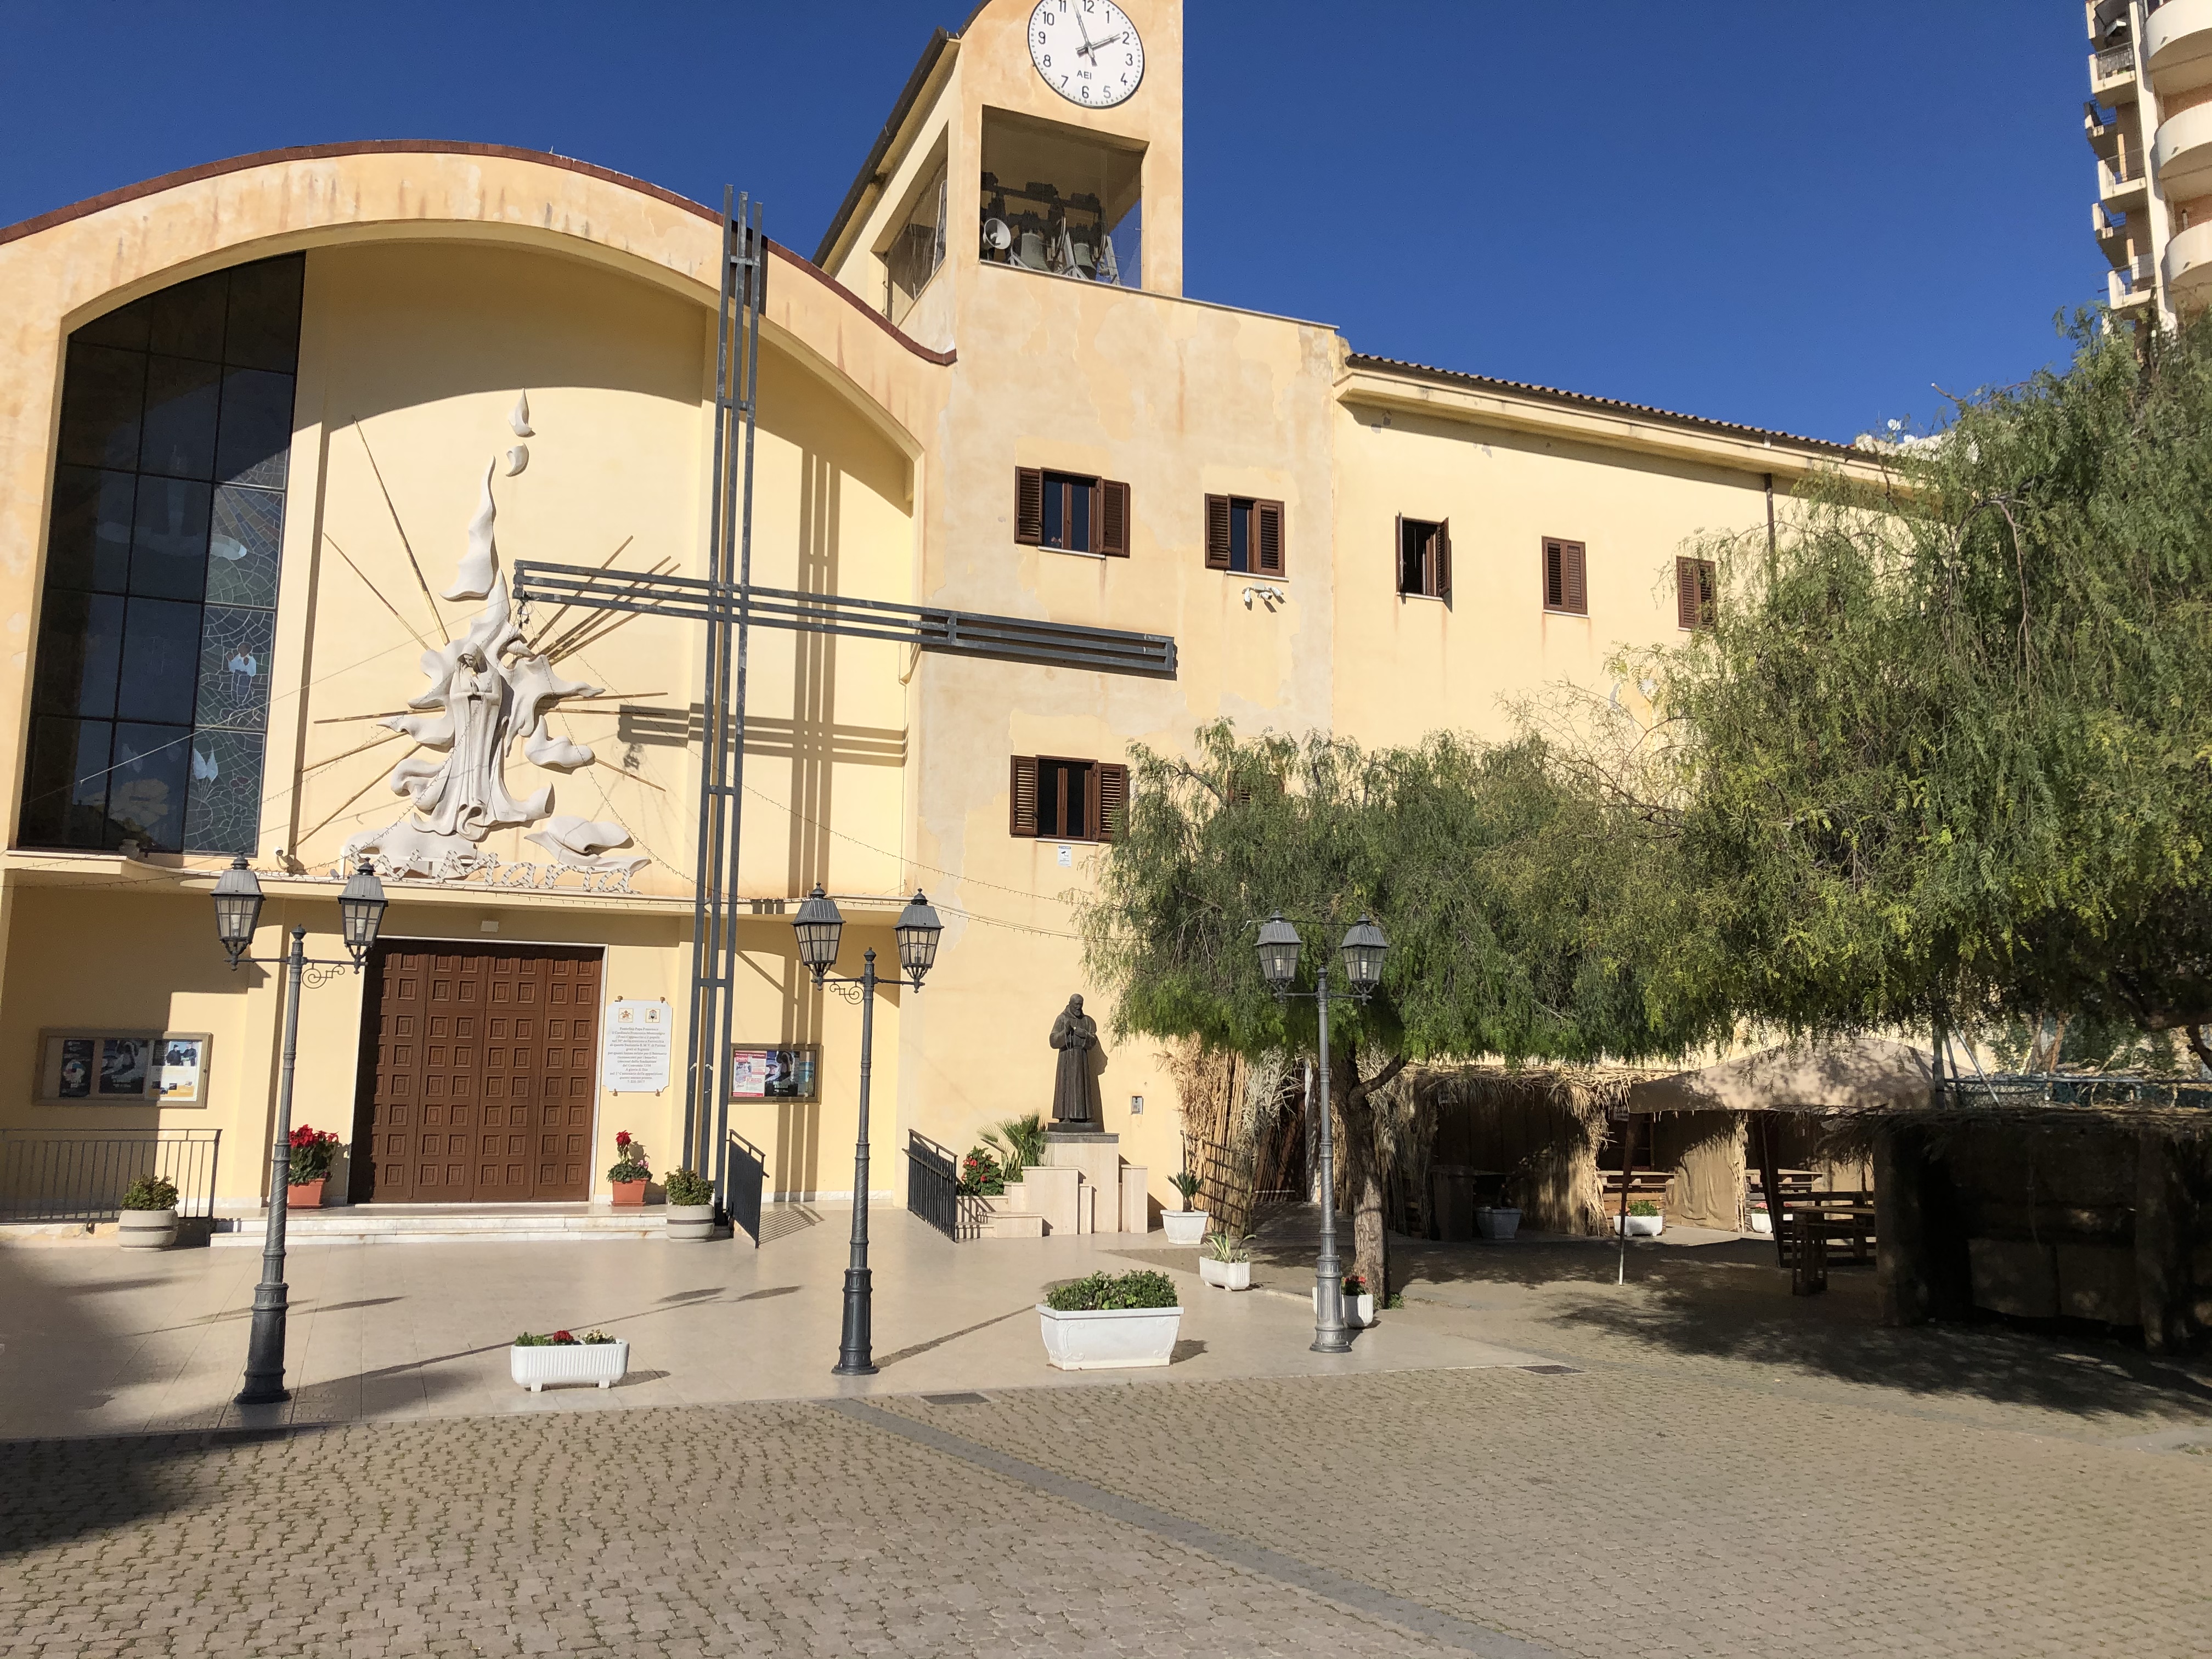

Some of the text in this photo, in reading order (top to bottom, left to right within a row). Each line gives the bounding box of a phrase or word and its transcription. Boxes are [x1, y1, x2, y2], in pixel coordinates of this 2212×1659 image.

[1058, 0, 1066, 13] 11
[1082, 0, 1094, 14] 12
[1042, 11, 1054, 26] 10
[1105, 10, 1110, 24] 1
[1038, 31, 1046, 44] 9
[1122, 31, 1130, 45] 2
[1043, 54, 1052, 67] 8
[1125, 53, 1133, 66] 3
[1060, 75, 1069, 88] 7
[1076, 70, 1092, 80] AEI
[1120, 73, 1128, 86] 4
[1082, 86, 1089, 99] 6
[1103, 86, 1111, 99] 5
[435, 850, 642, 895] Maria
